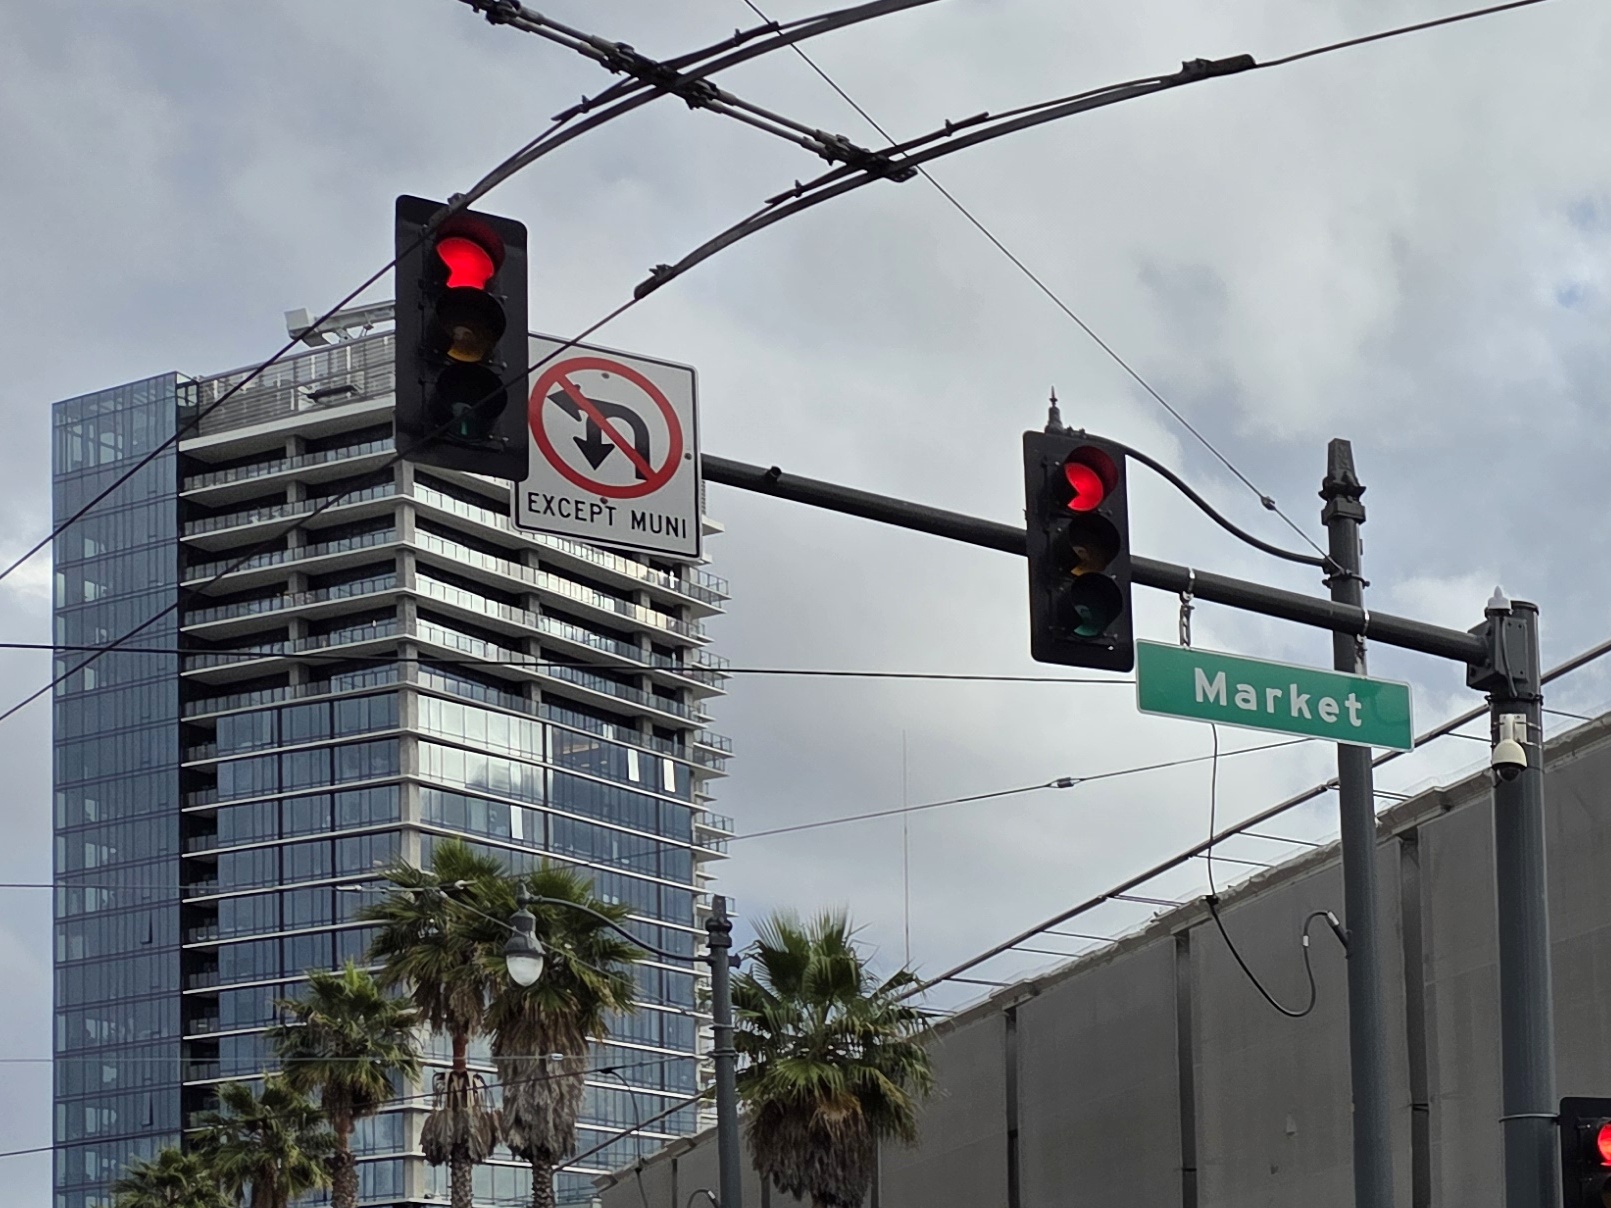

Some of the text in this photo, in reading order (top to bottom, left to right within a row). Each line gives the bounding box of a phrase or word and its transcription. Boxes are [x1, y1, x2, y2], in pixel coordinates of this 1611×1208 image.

[528, 491, 687, 539] EXCEPT MUNI
[1194, 667, 1362, 727] Market
